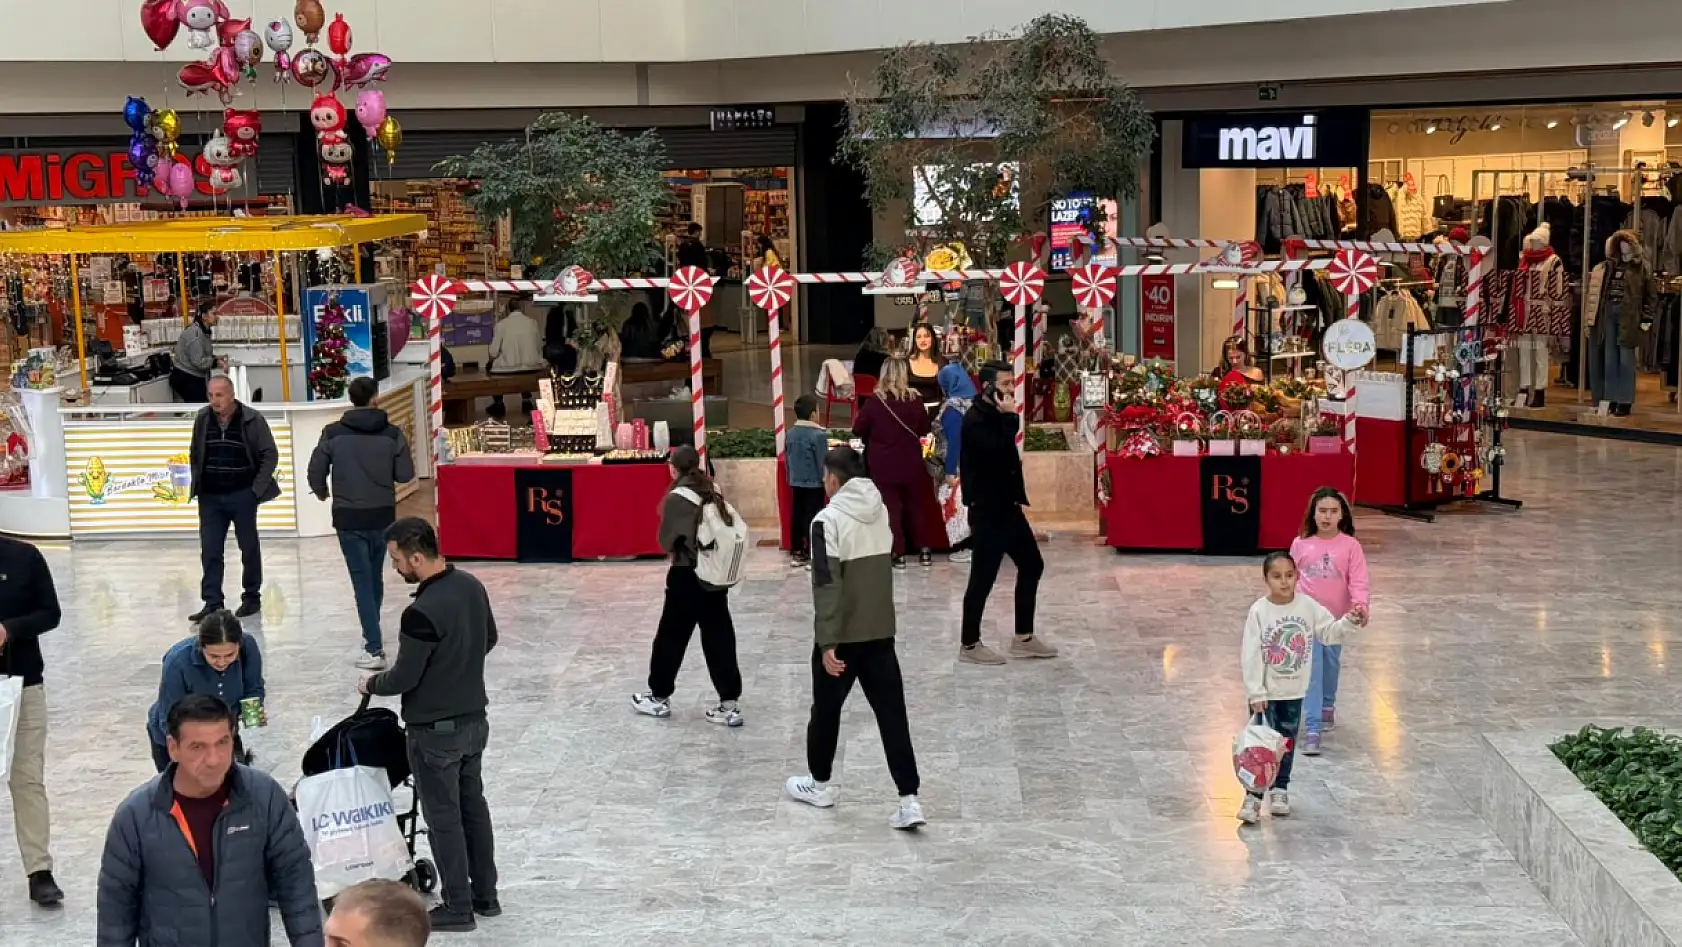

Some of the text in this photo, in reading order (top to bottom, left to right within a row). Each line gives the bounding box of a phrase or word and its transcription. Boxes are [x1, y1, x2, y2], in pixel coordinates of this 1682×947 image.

[1219, 115, 1317, 160] mavi
[0, 152, 230, 200] MiGRS
[313, 304, 363, 323] Ekli
[312, 813, 330, 832] LC
